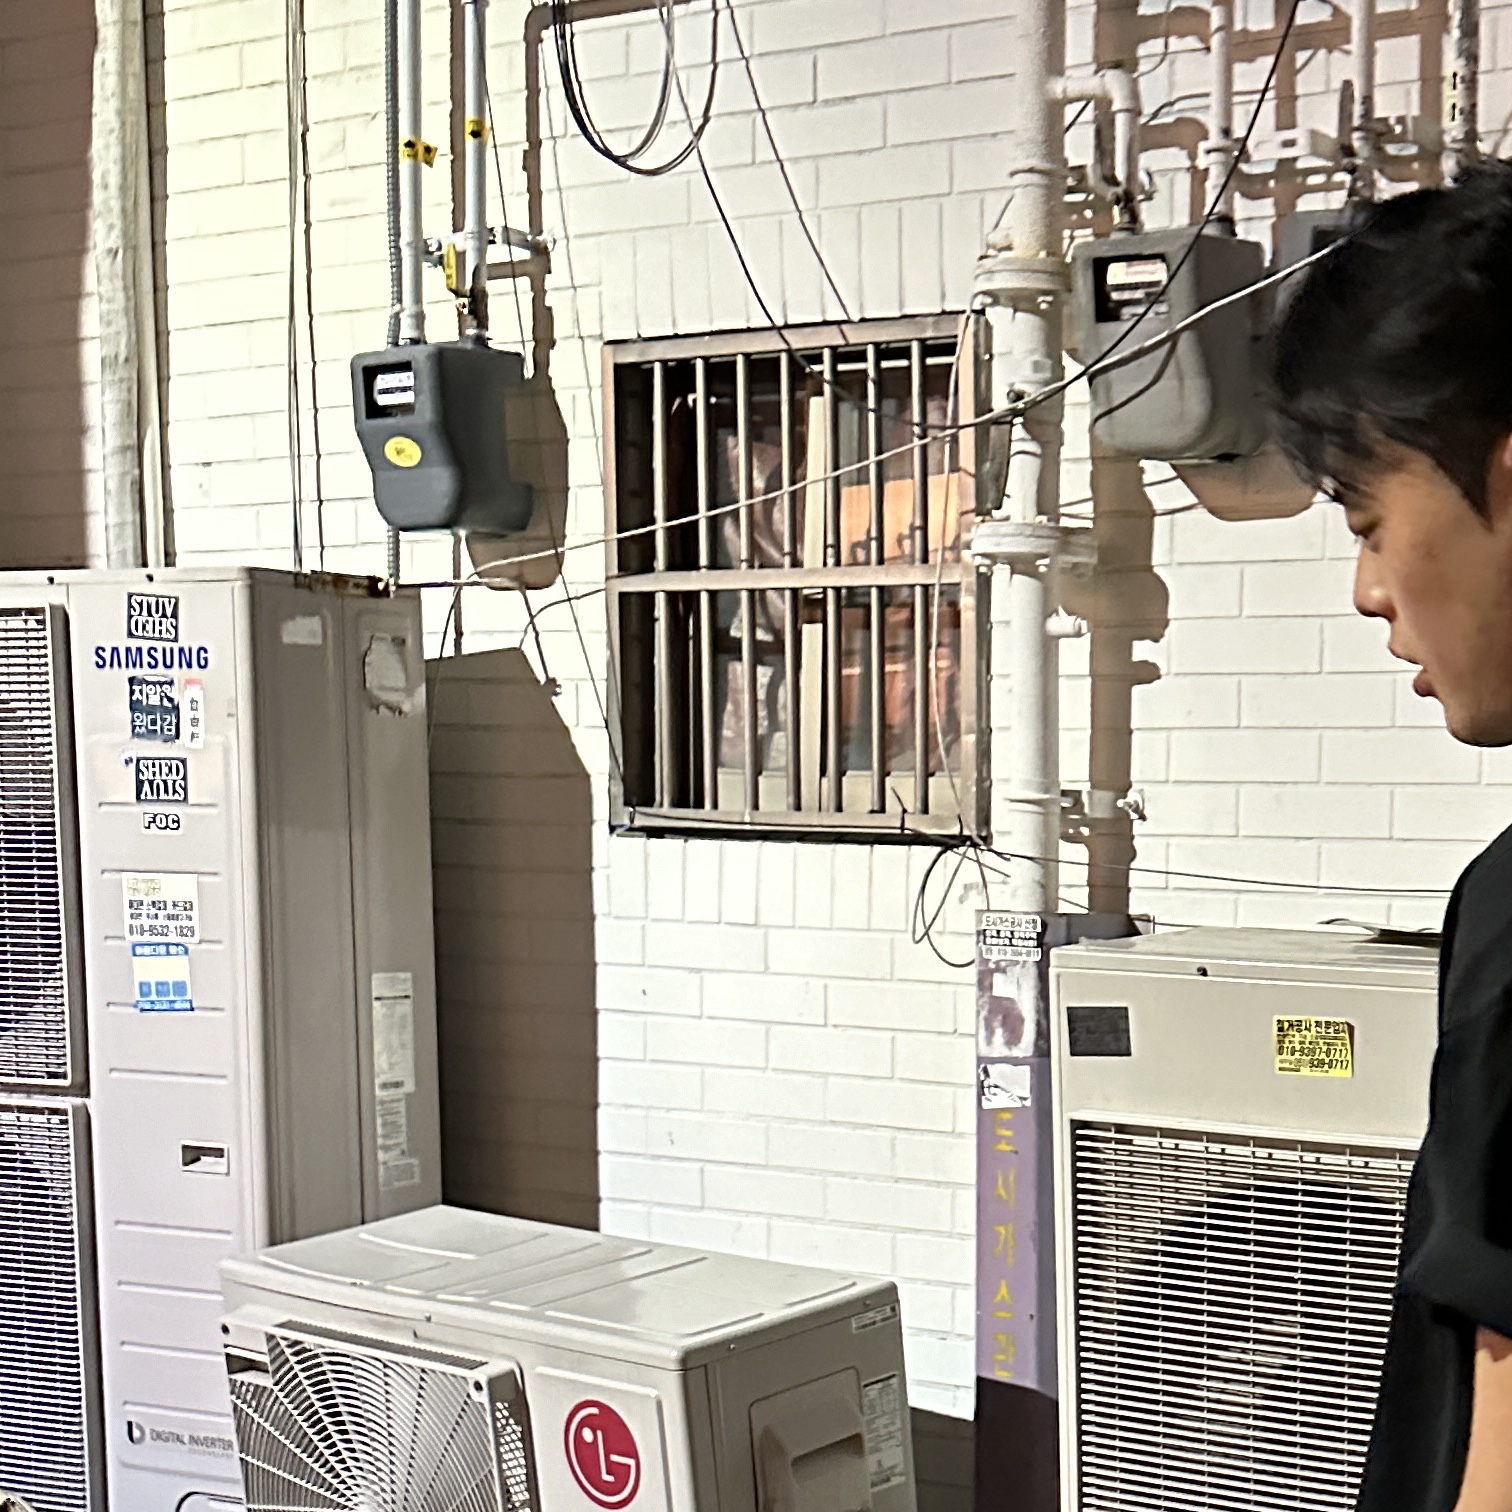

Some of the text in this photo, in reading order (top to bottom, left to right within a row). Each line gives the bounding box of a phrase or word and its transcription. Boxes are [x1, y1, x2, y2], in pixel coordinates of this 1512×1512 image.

[130, 595, 176, 618] STUV
[94, 646, 209, 669] SAMSUNG
[139, 759, 185, 780] SHED
[143, 812, 180, 830] FOC
[1276, 1019, 1312, 1033] 철거공사
[149, 1427, 235, 1452] DIGITAL INVERTER
